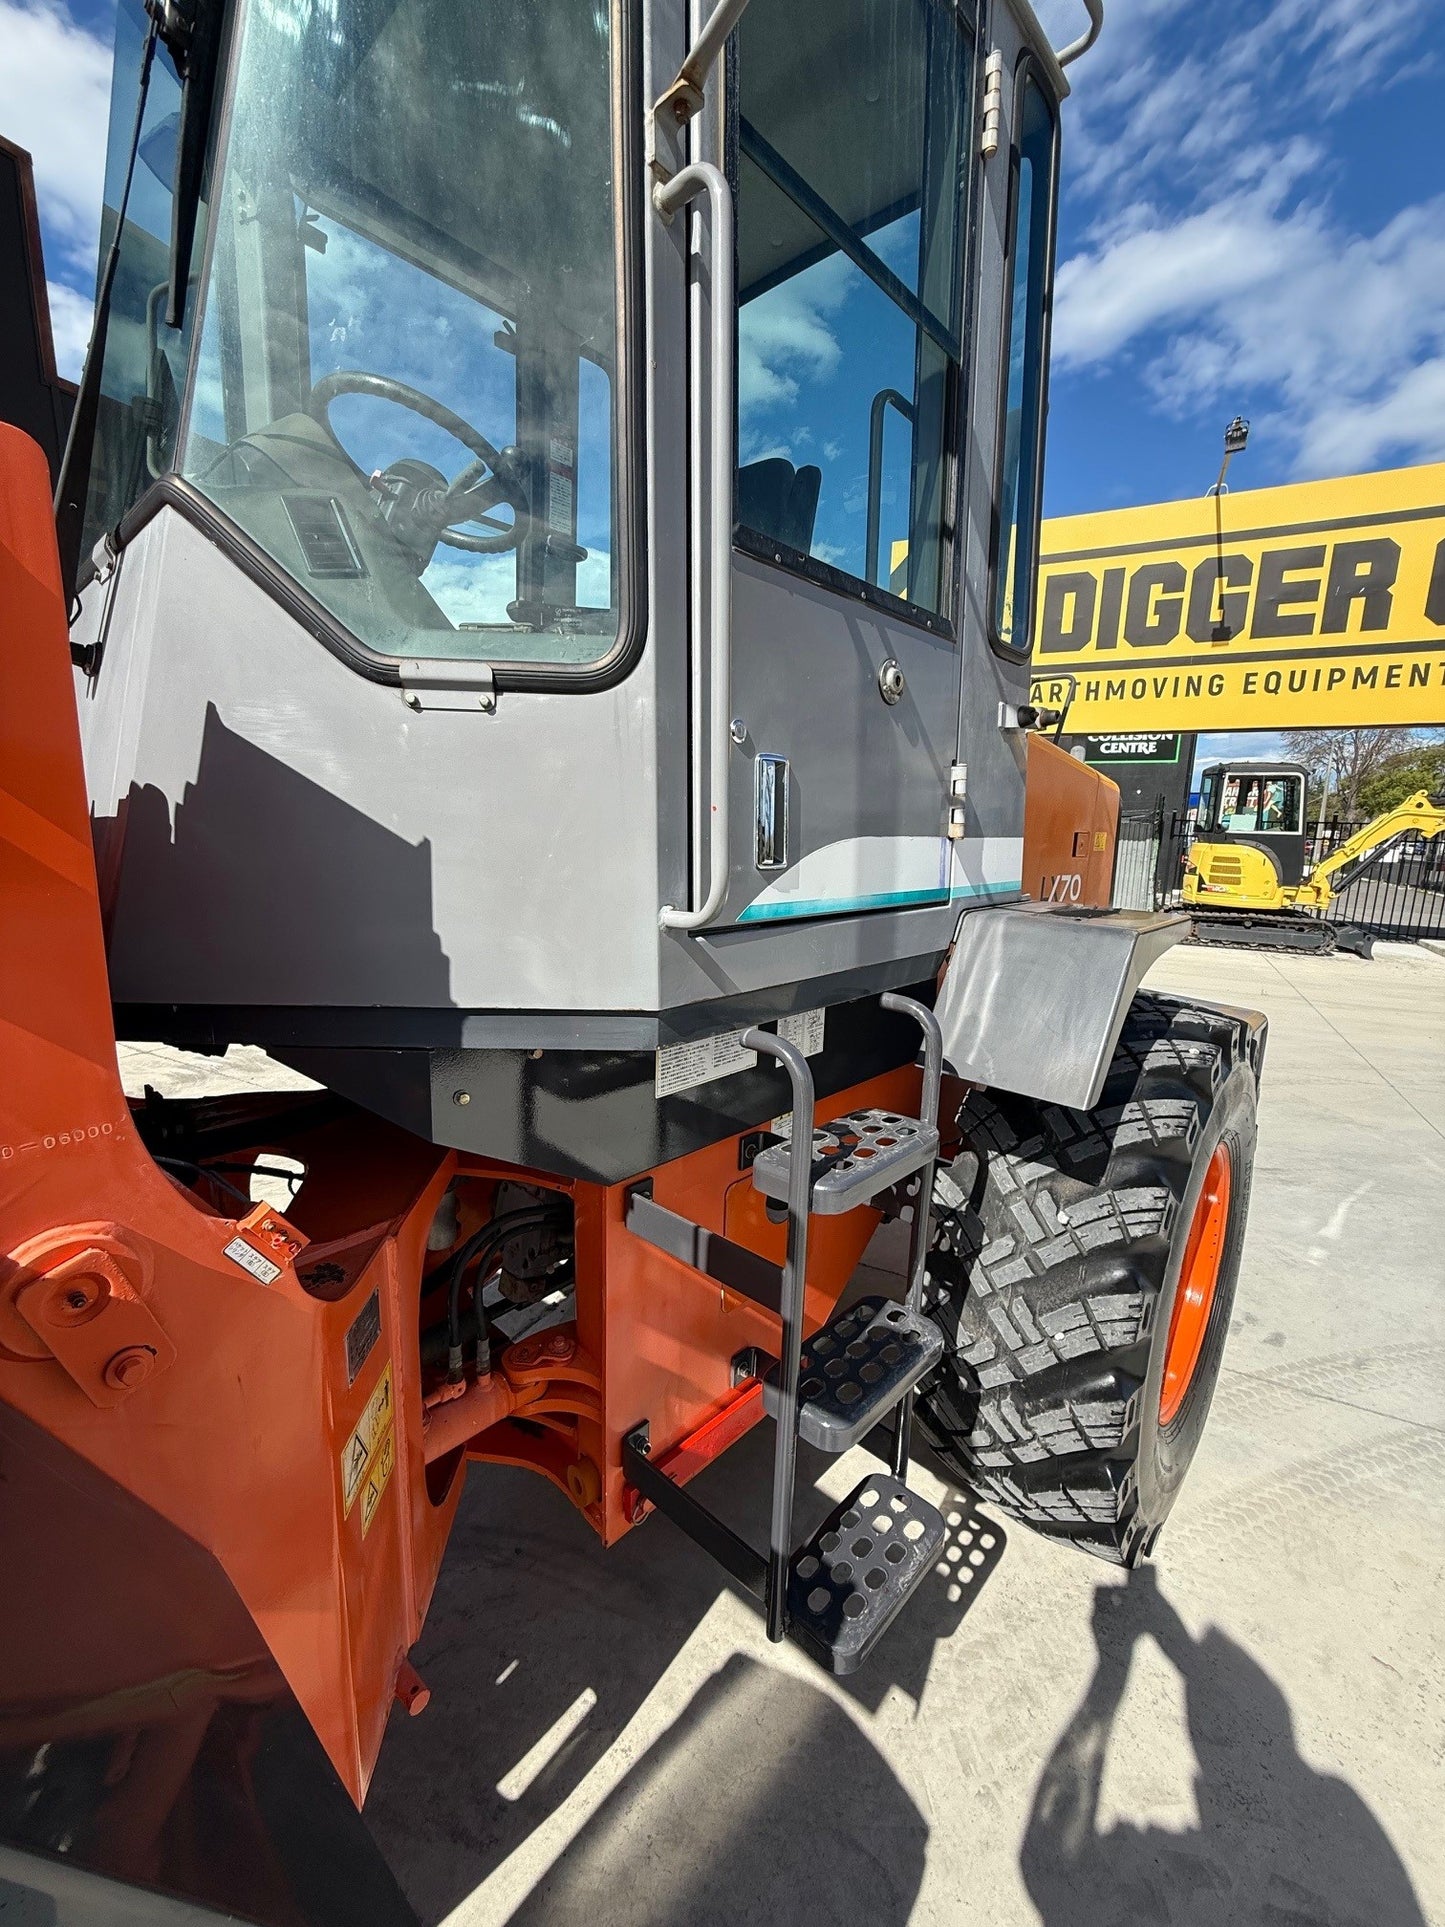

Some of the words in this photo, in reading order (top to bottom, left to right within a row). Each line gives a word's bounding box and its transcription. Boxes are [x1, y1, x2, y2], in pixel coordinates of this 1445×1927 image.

[1040, 538, 1401, 654] DIGGER
[1030, 673, 1226, 703] ARTHMOVING
[1100, 742, 1157, 755] CENTRE
[1040, 874, 1082, 902] LX70
